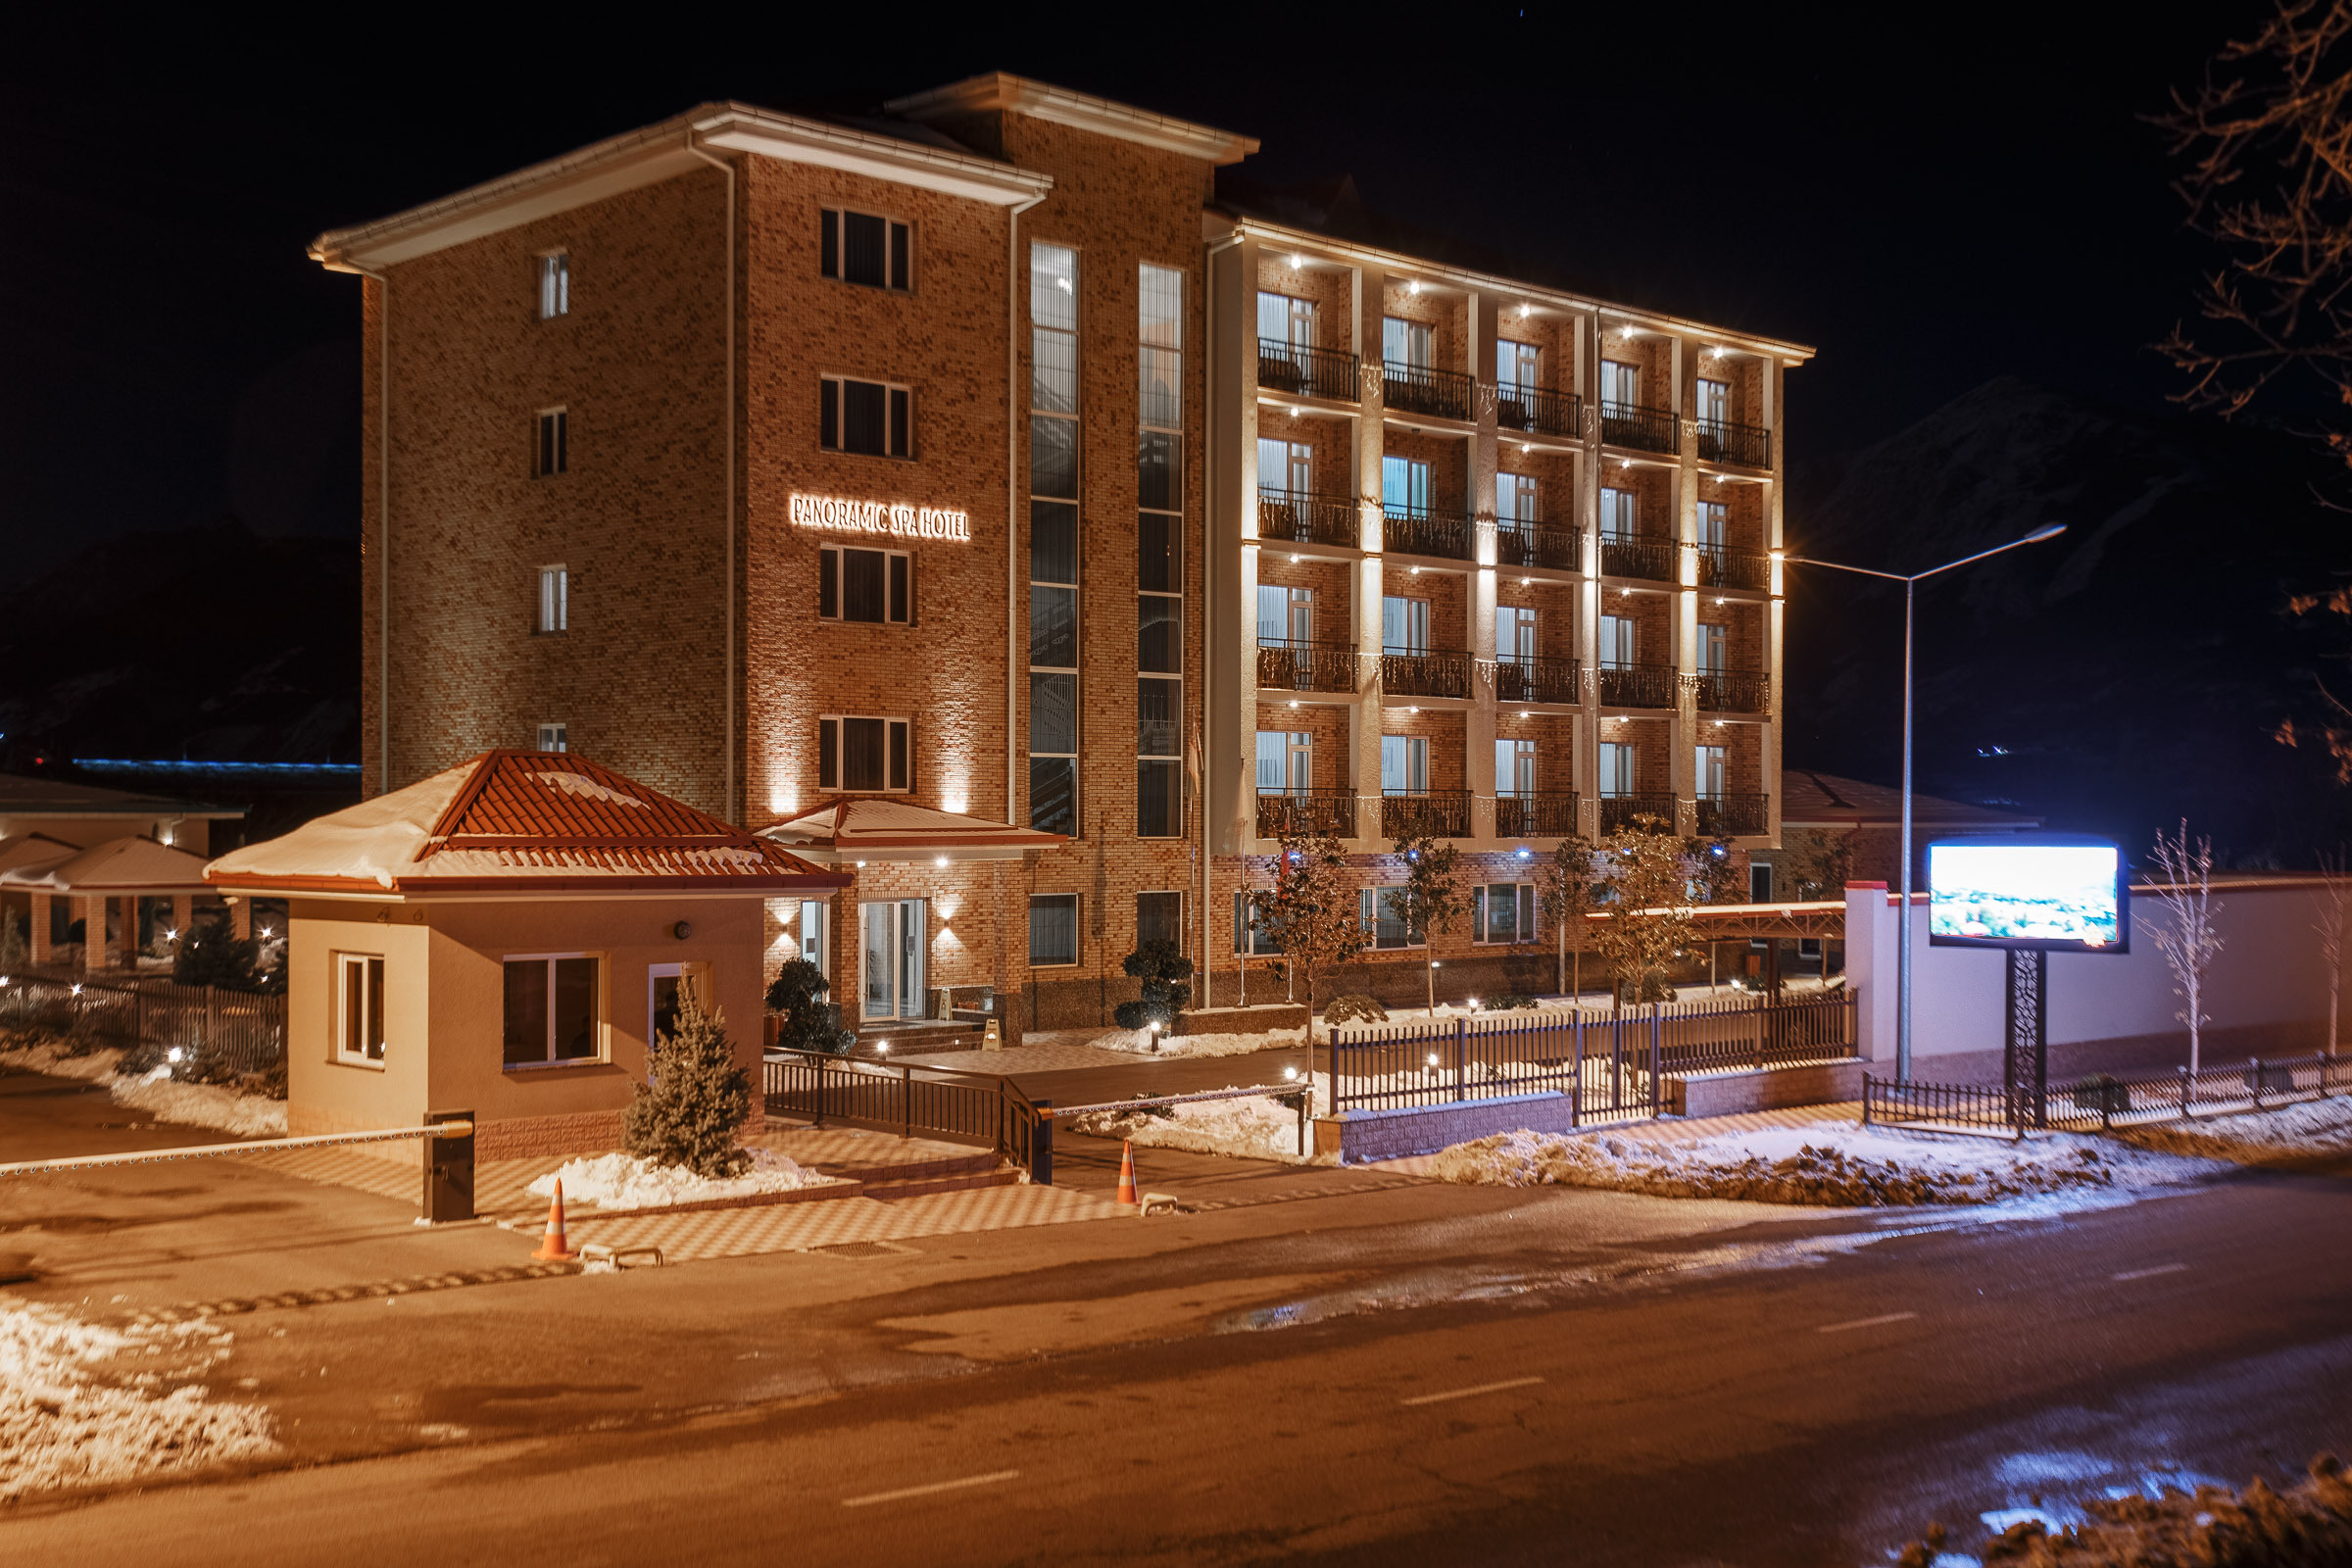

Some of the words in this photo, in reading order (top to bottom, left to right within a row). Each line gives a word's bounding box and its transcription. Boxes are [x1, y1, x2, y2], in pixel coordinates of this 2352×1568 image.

[793, 498, 890, 531] PANORAMIC
[893, 509, 918, 535] SPA
[923, 512, 970, 538] HOTEL
